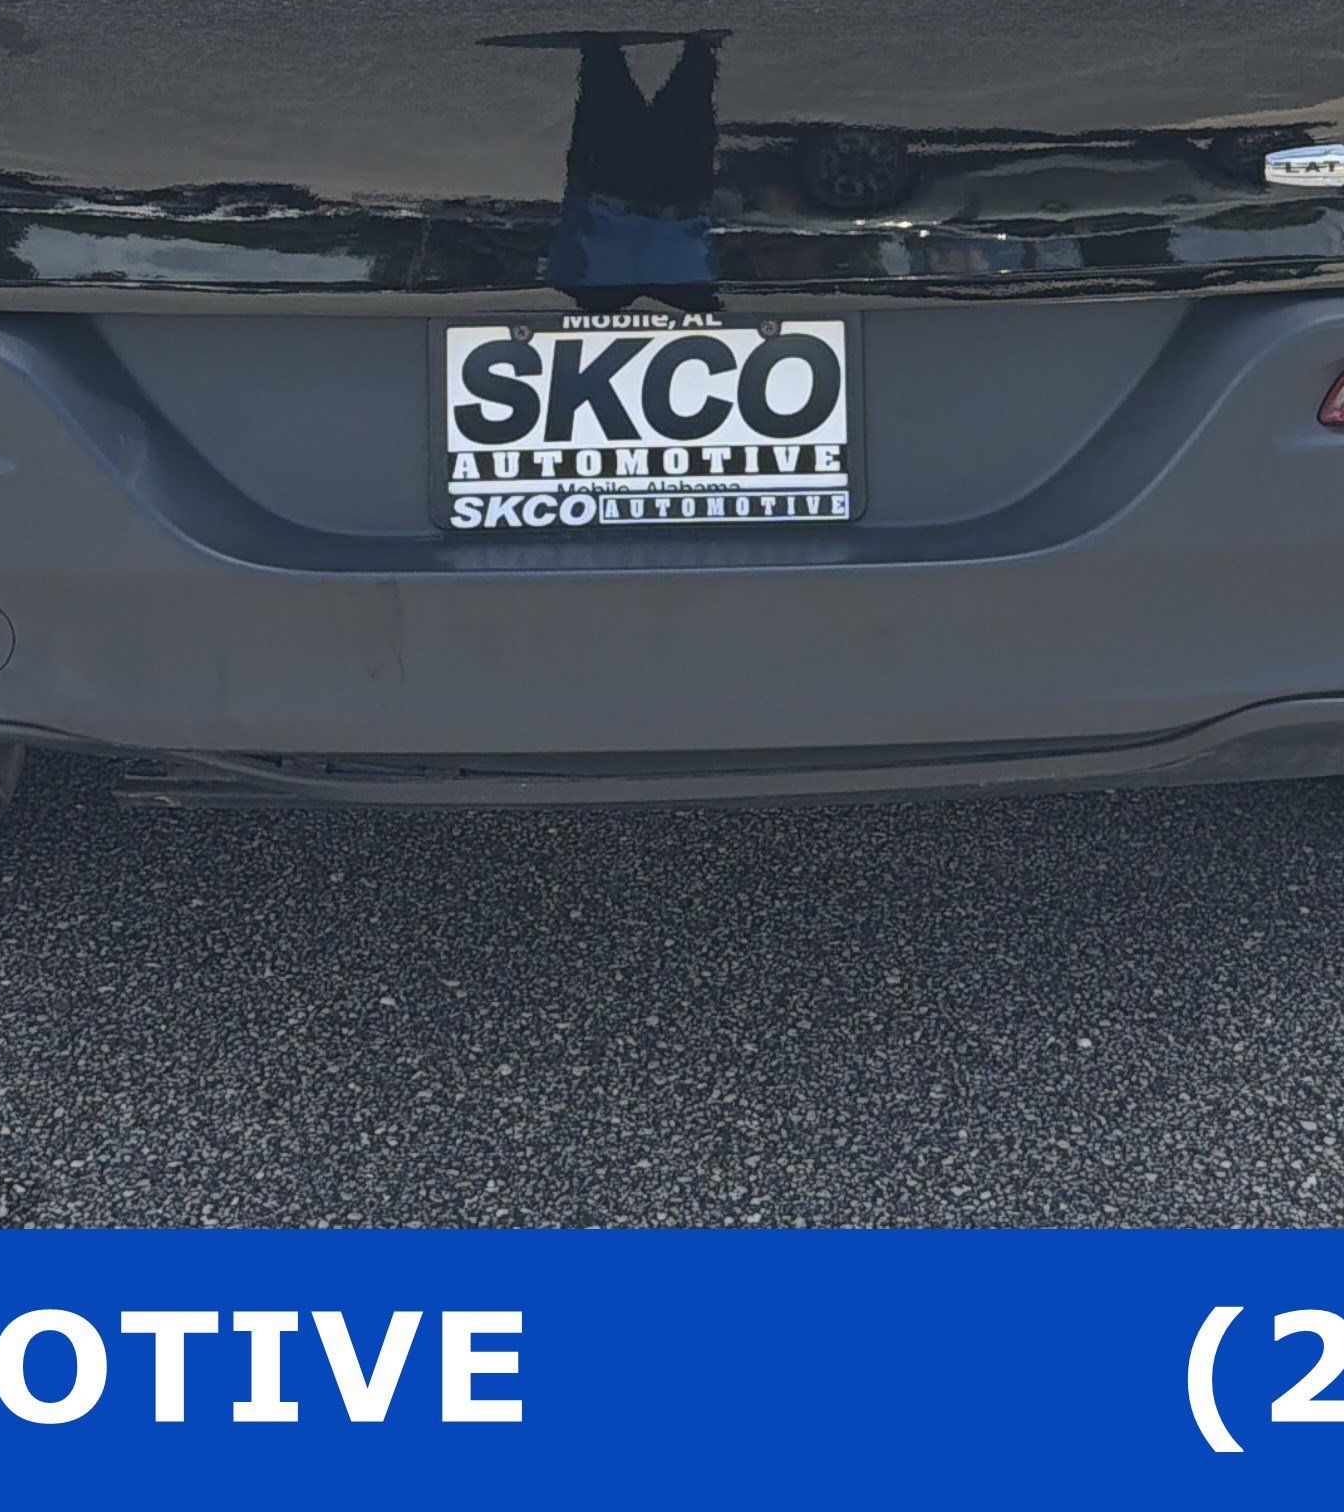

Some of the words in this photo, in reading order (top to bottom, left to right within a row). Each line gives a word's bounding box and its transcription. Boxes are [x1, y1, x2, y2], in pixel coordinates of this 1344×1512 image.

[682, 312, 723, 327] AL
[453, 332, 842, 445] SKCO
[452, 445, 842, 479] AUTOMOTIVE
[450, 493, 597, 528] SKCO
[605, 494, 846, 517] AUTOMOTIVE
